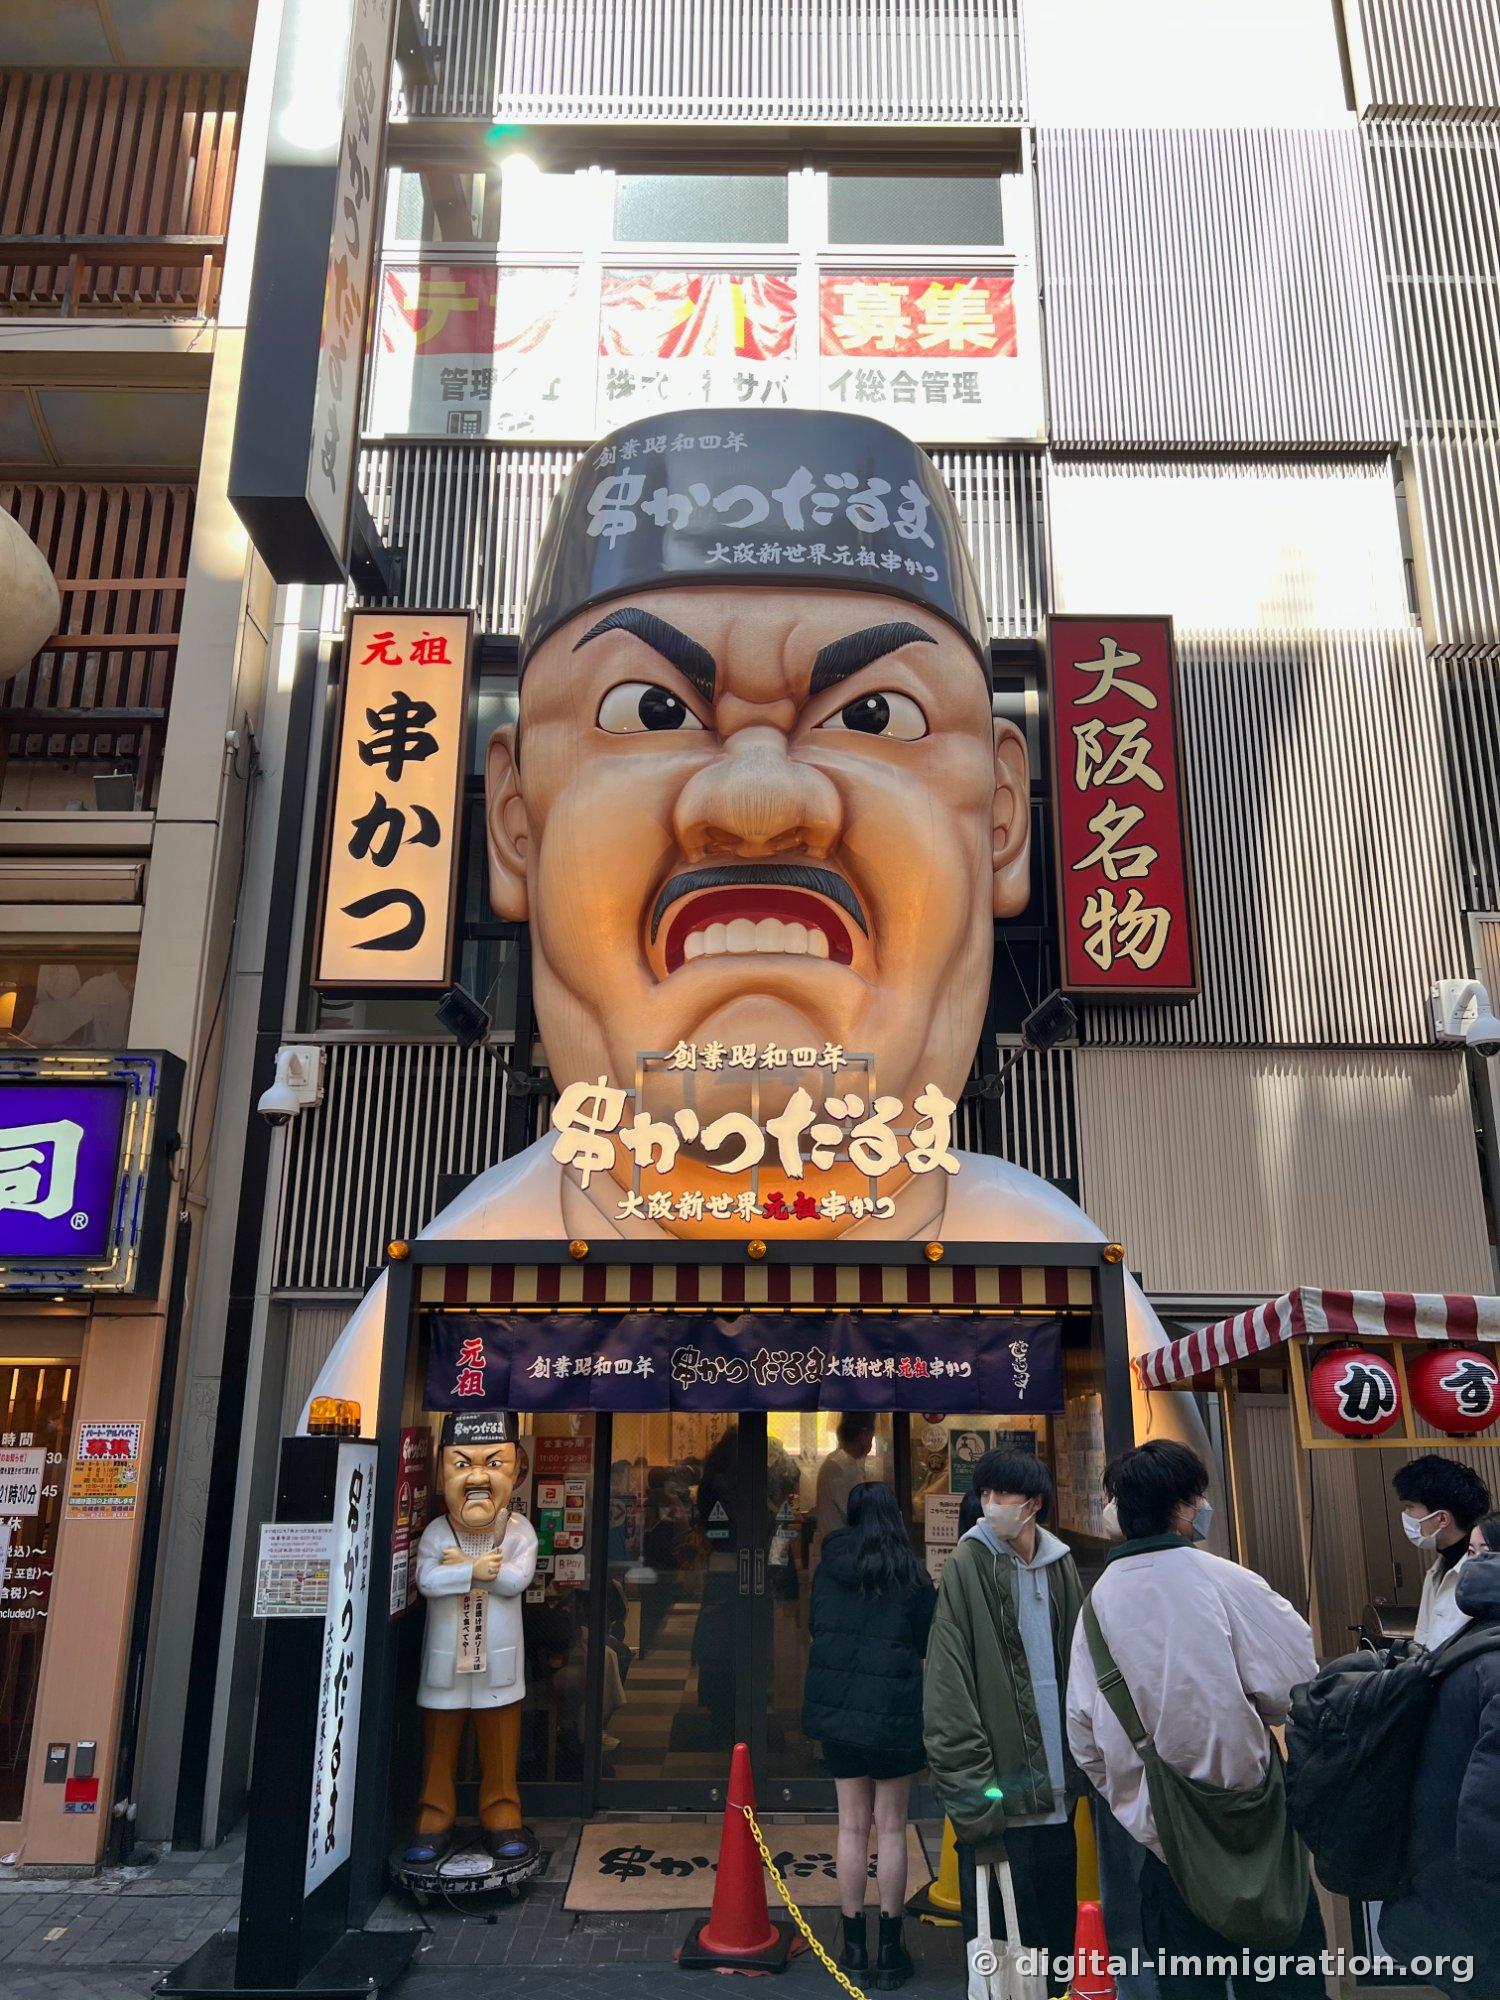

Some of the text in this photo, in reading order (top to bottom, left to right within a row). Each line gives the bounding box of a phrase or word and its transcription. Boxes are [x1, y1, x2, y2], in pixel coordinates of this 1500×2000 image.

[594, 430, 748, 471] 創業昭和四年
[585, 465, 935, 550] 串かつだるま
[705, 540, 939, 582] 大阪新世界元祖串かつ
[360, 631, 452, 666] 元祖
[339, 690, 441, 952] 串かつ
[1072, 636, 1172, 971] 大阪名物
[664, 1041, 847, 1072] 創業昭和四年
[551, 1075, 961, 1190] 串かつだるま
[614, 1190, 897, 1223] 大阪新世界元祖串かつ
[451, 1337, 486, 1397] 元祖
[526, 1355, 655, 1380] 創業昭和四年
[671, 1345, 824, 1390] 串かつだるま
[825, 1356, 972, 1379] 大阪新世界元祖串かつ
[1439, 1358, 1499, 1416] す
[1334, 1361, 1398, 1424] か
[46, 1452, 62, 1464] 30
[41, 1484, 58, 1497] 45
